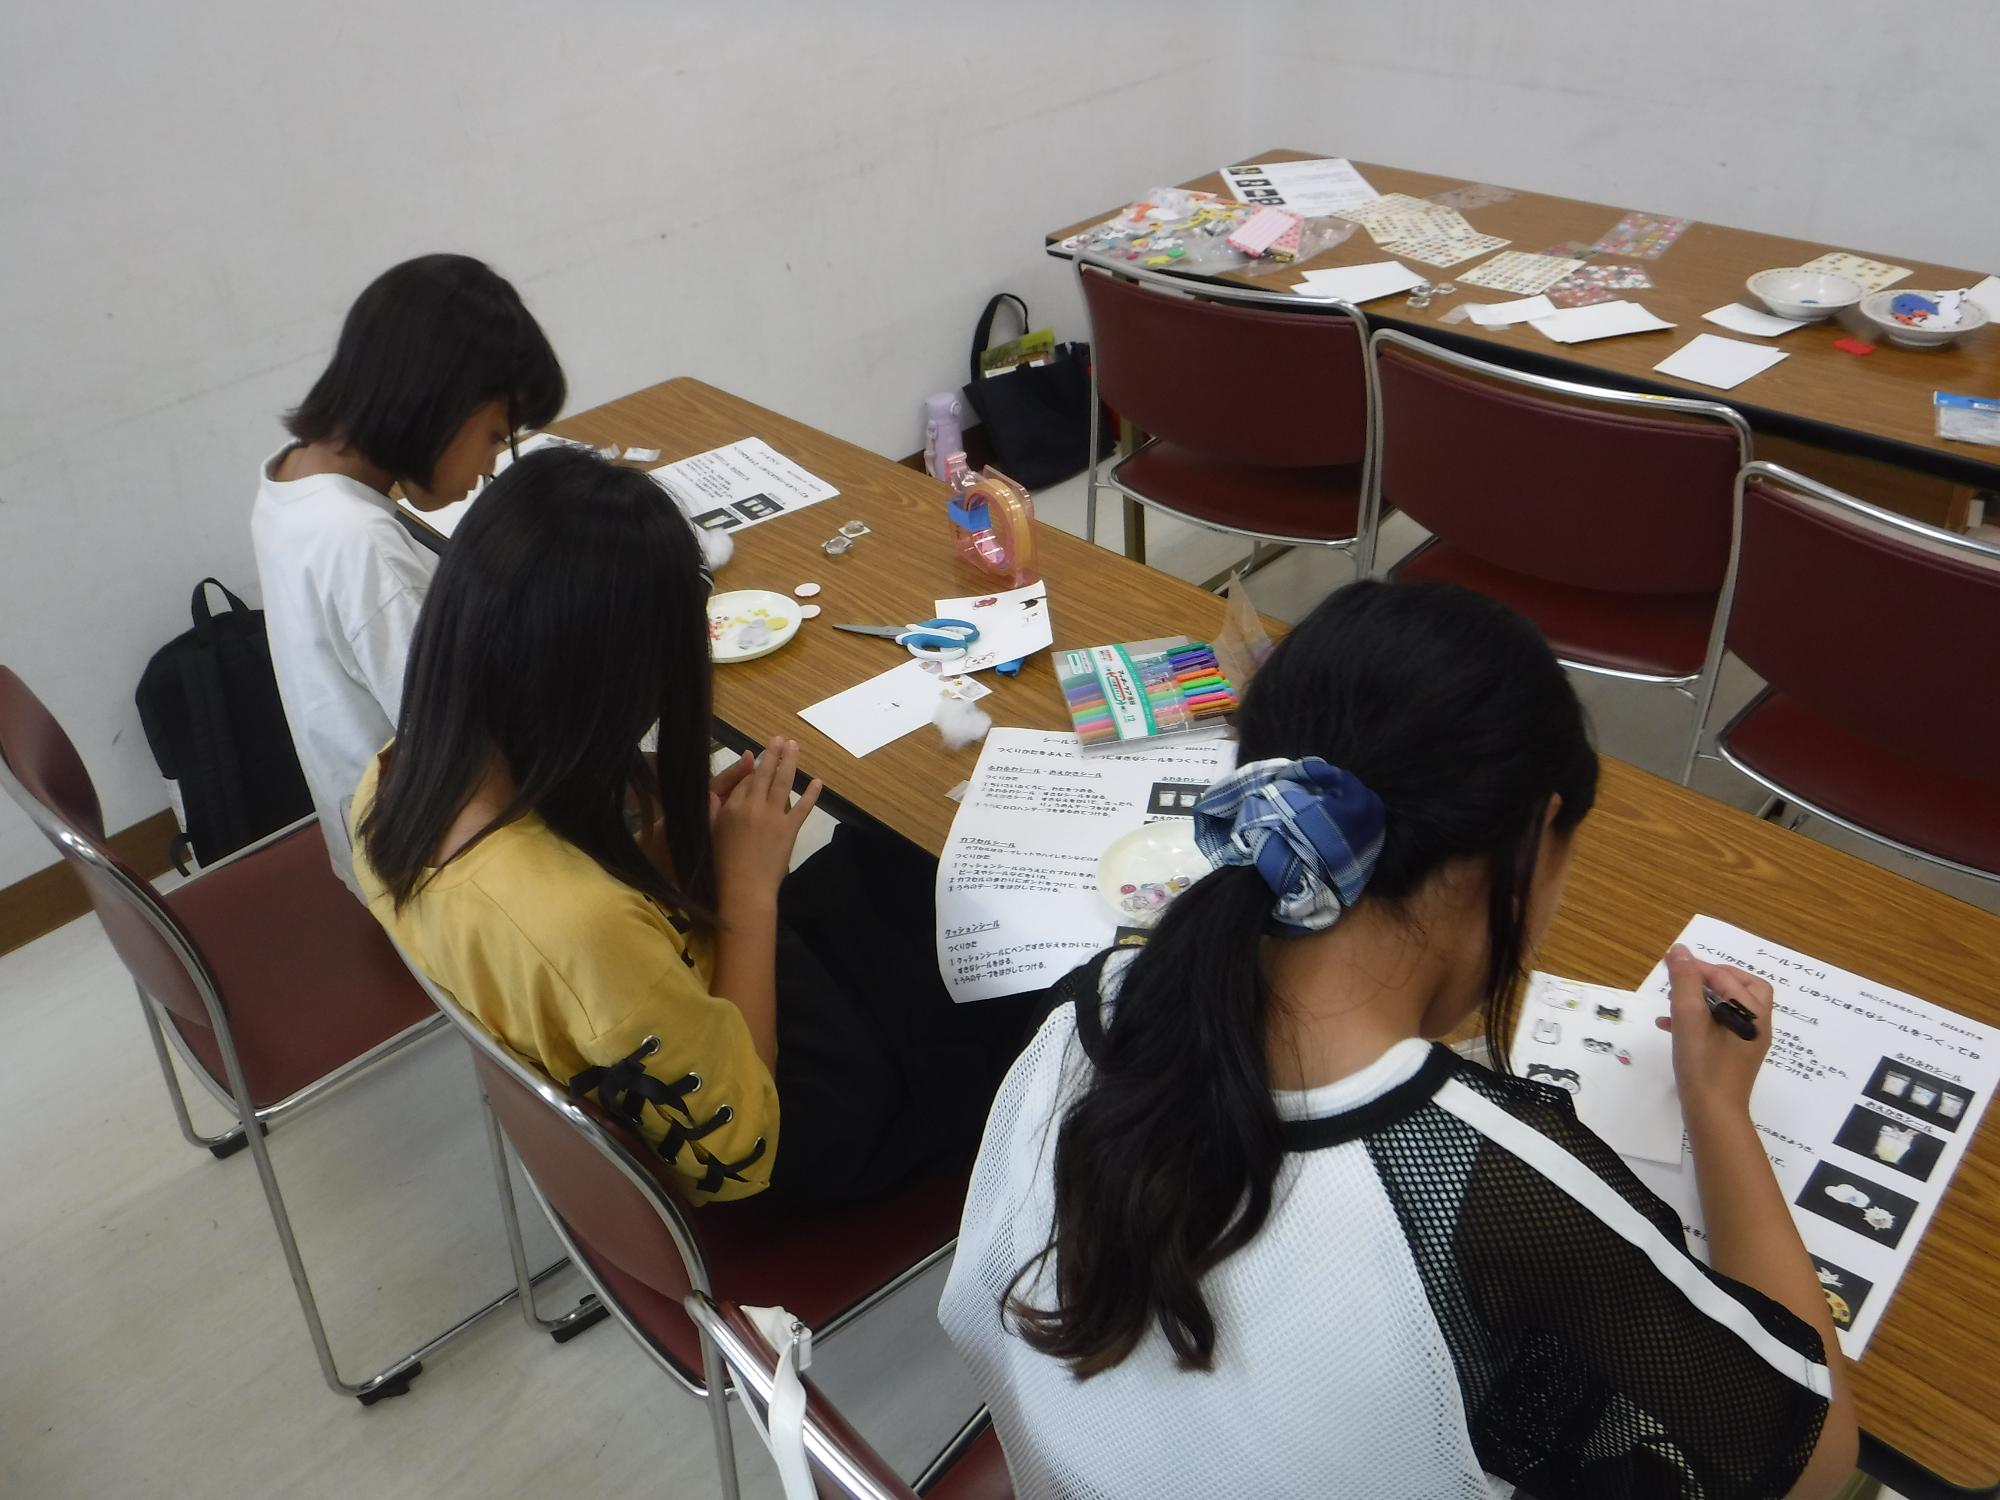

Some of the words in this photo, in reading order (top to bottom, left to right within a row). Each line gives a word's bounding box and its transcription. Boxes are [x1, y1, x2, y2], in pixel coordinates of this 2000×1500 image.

[944, 920, 1000, 938] クッションシール
[1756, 948, 1826, 980] シールづくり
[1896, 1052, 1962, 1083] ふわふわシール
[1866, 1100, 1934, 1133] おえかきシール
